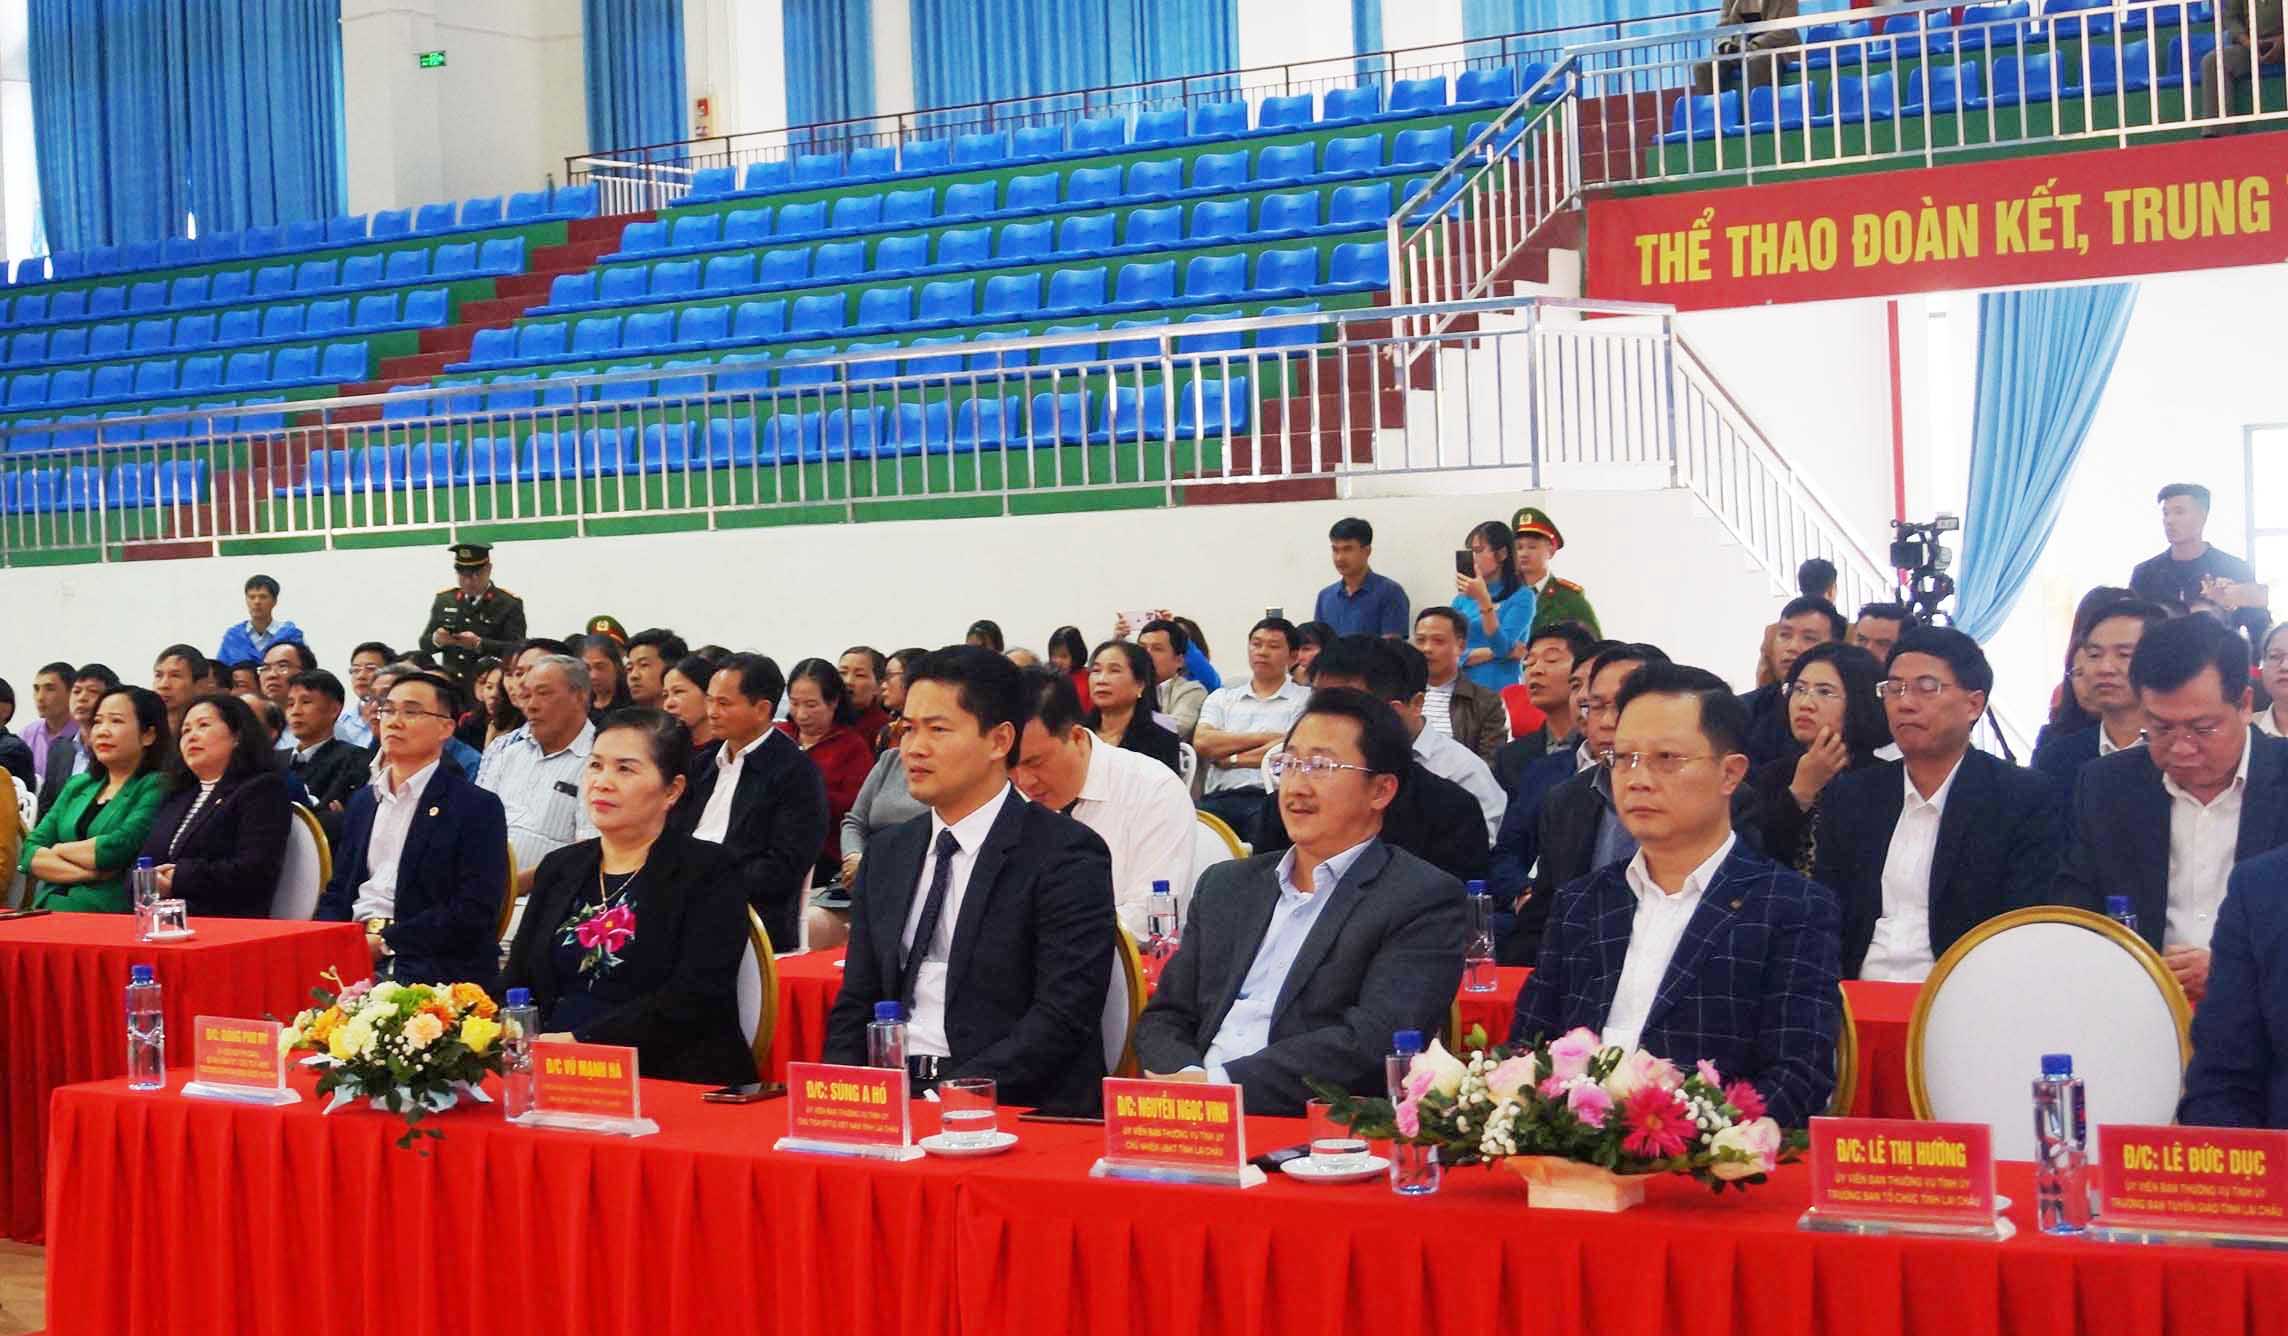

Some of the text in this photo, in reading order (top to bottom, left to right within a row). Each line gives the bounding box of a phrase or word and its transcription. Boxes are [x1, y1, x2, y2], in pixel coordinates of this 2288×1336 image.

[1635, 176, 2271, 286] THỂ THAO ĐOÀN KẾT, TRUNG
[862, 1085, 870, 1103] A
[1836, 1137, 1865, 1163] Đ/C:
[1868, 1134, 1886, 1164] LÊ
[1889, 1139, 1912, 1171] THỊ
[2123, 1141, 2266, 1181] Đ/C: LÊ ĐỨC DỤC
